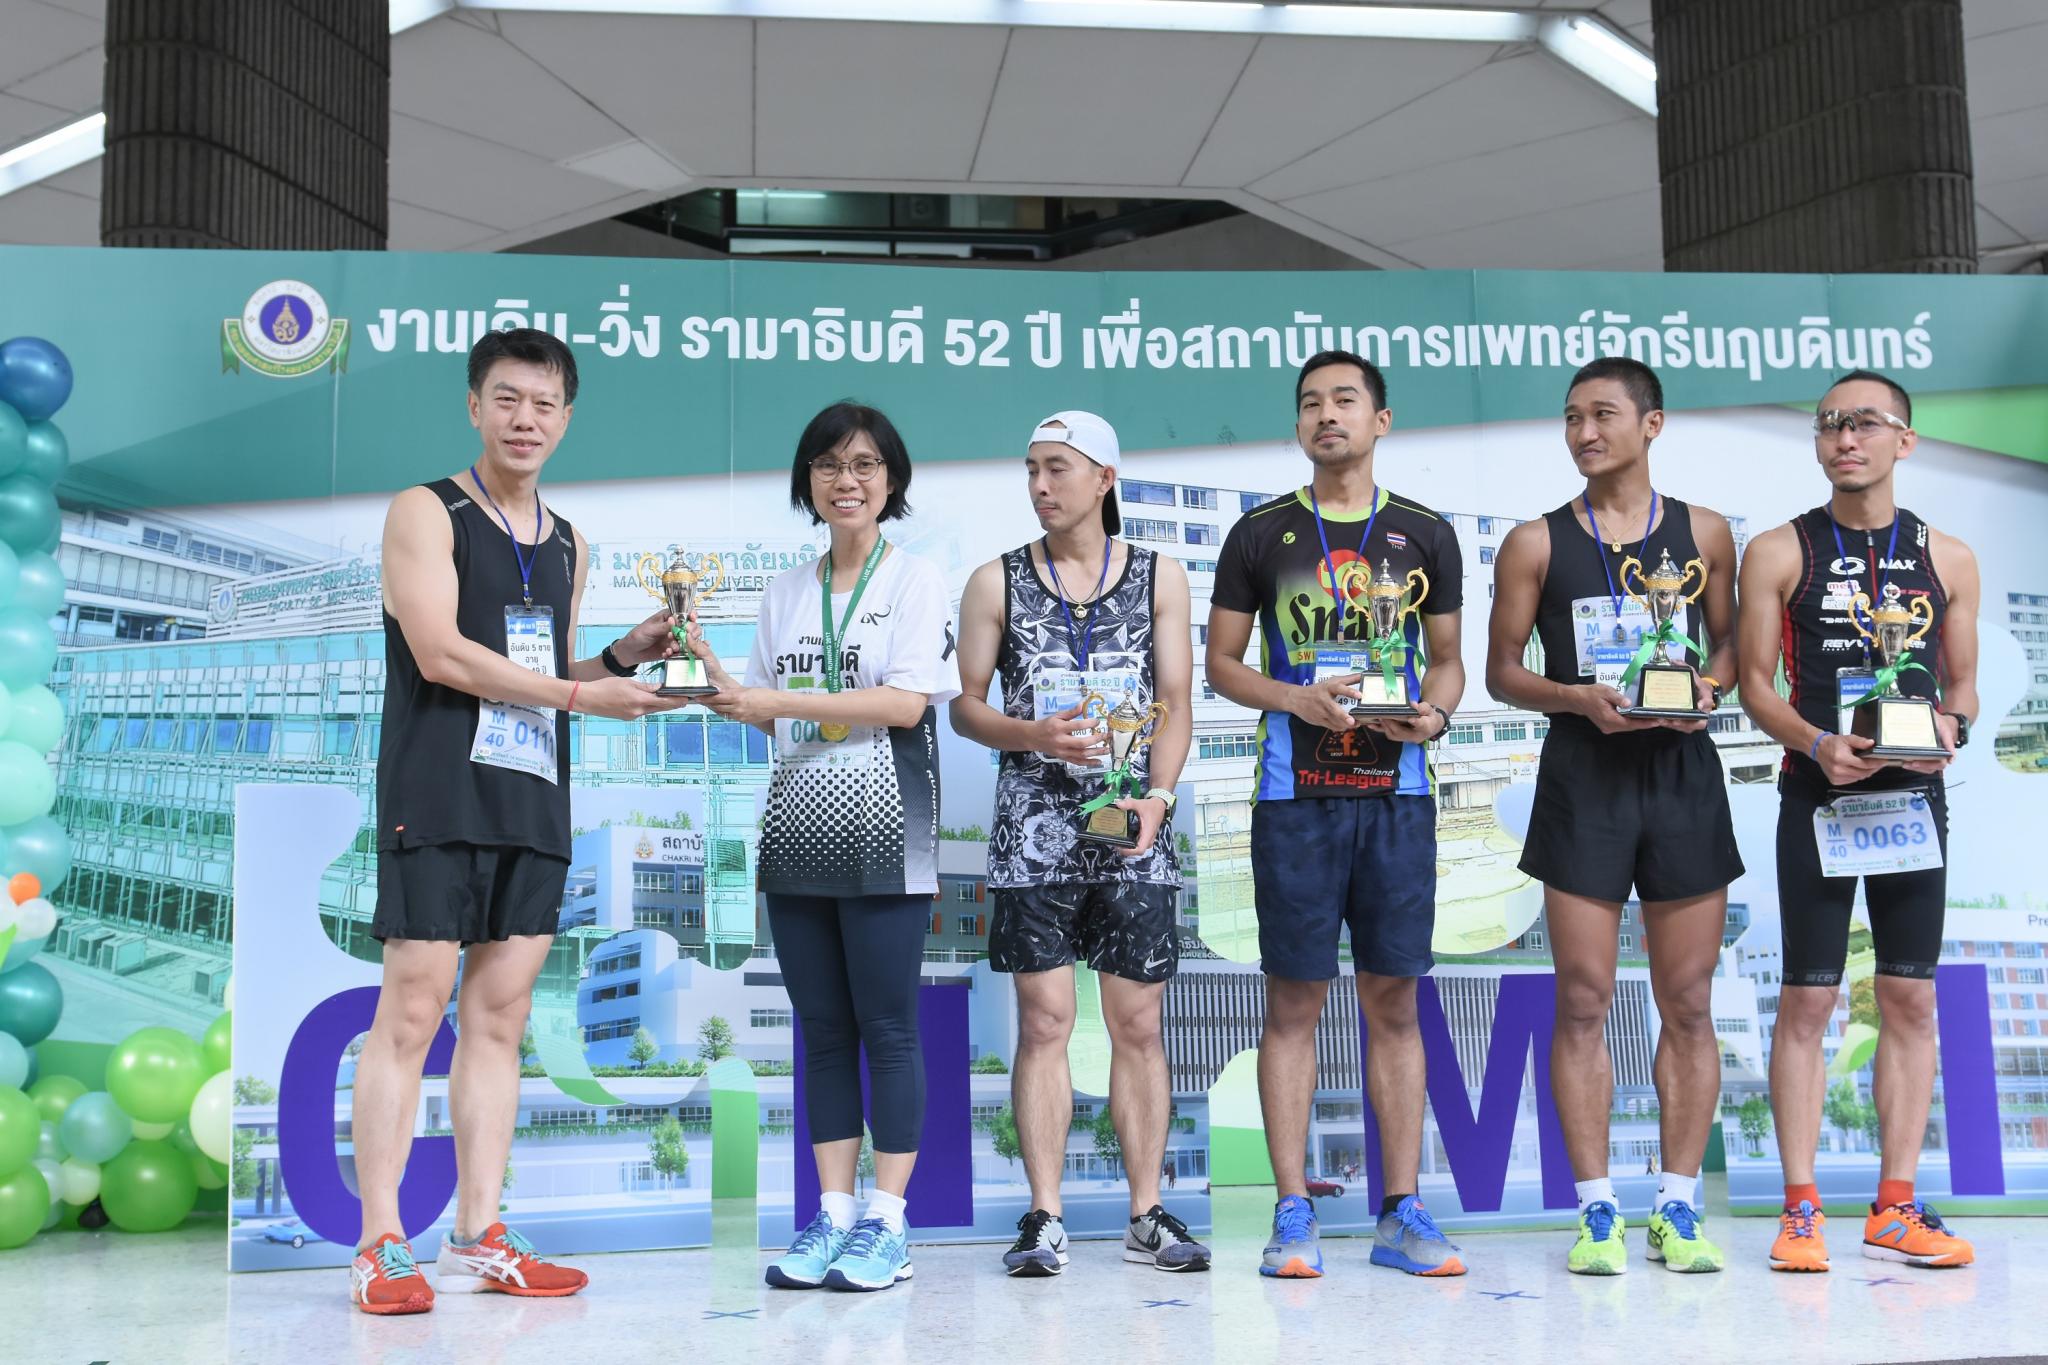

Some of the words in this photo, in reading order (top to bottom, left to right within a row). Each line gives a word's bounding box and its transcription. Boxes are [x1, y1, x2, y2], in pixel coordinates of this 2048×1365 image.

[681, 306, 924, 364] รามาธิบดี
[944, 319, 1010, 367] 52
[1024, 310, 1062, 368] ปี
[1083, 297, 1933, 381] เพื่อสถาบันการแพทย์จักรีนฤบดินทร์
[1586, 623, 1599, 636] M
[532, 644, 537, 652] 5
[1045, 697, 1058, 710] M
[492, 710, 506, 725] M
[485, 733, 505, 747] 40
[1353, 767, 1395, 777] Thailand
[1298, 769, 1393, 789] Tri-League
[1885, 799, 1897, 808] 52
[1827, 824, 1842, 837] M
[1854, 822, 1927, 850] 0063
[1829, 845, 1847, 858] 40
[662, 854, 692, 863] CHAKRI
